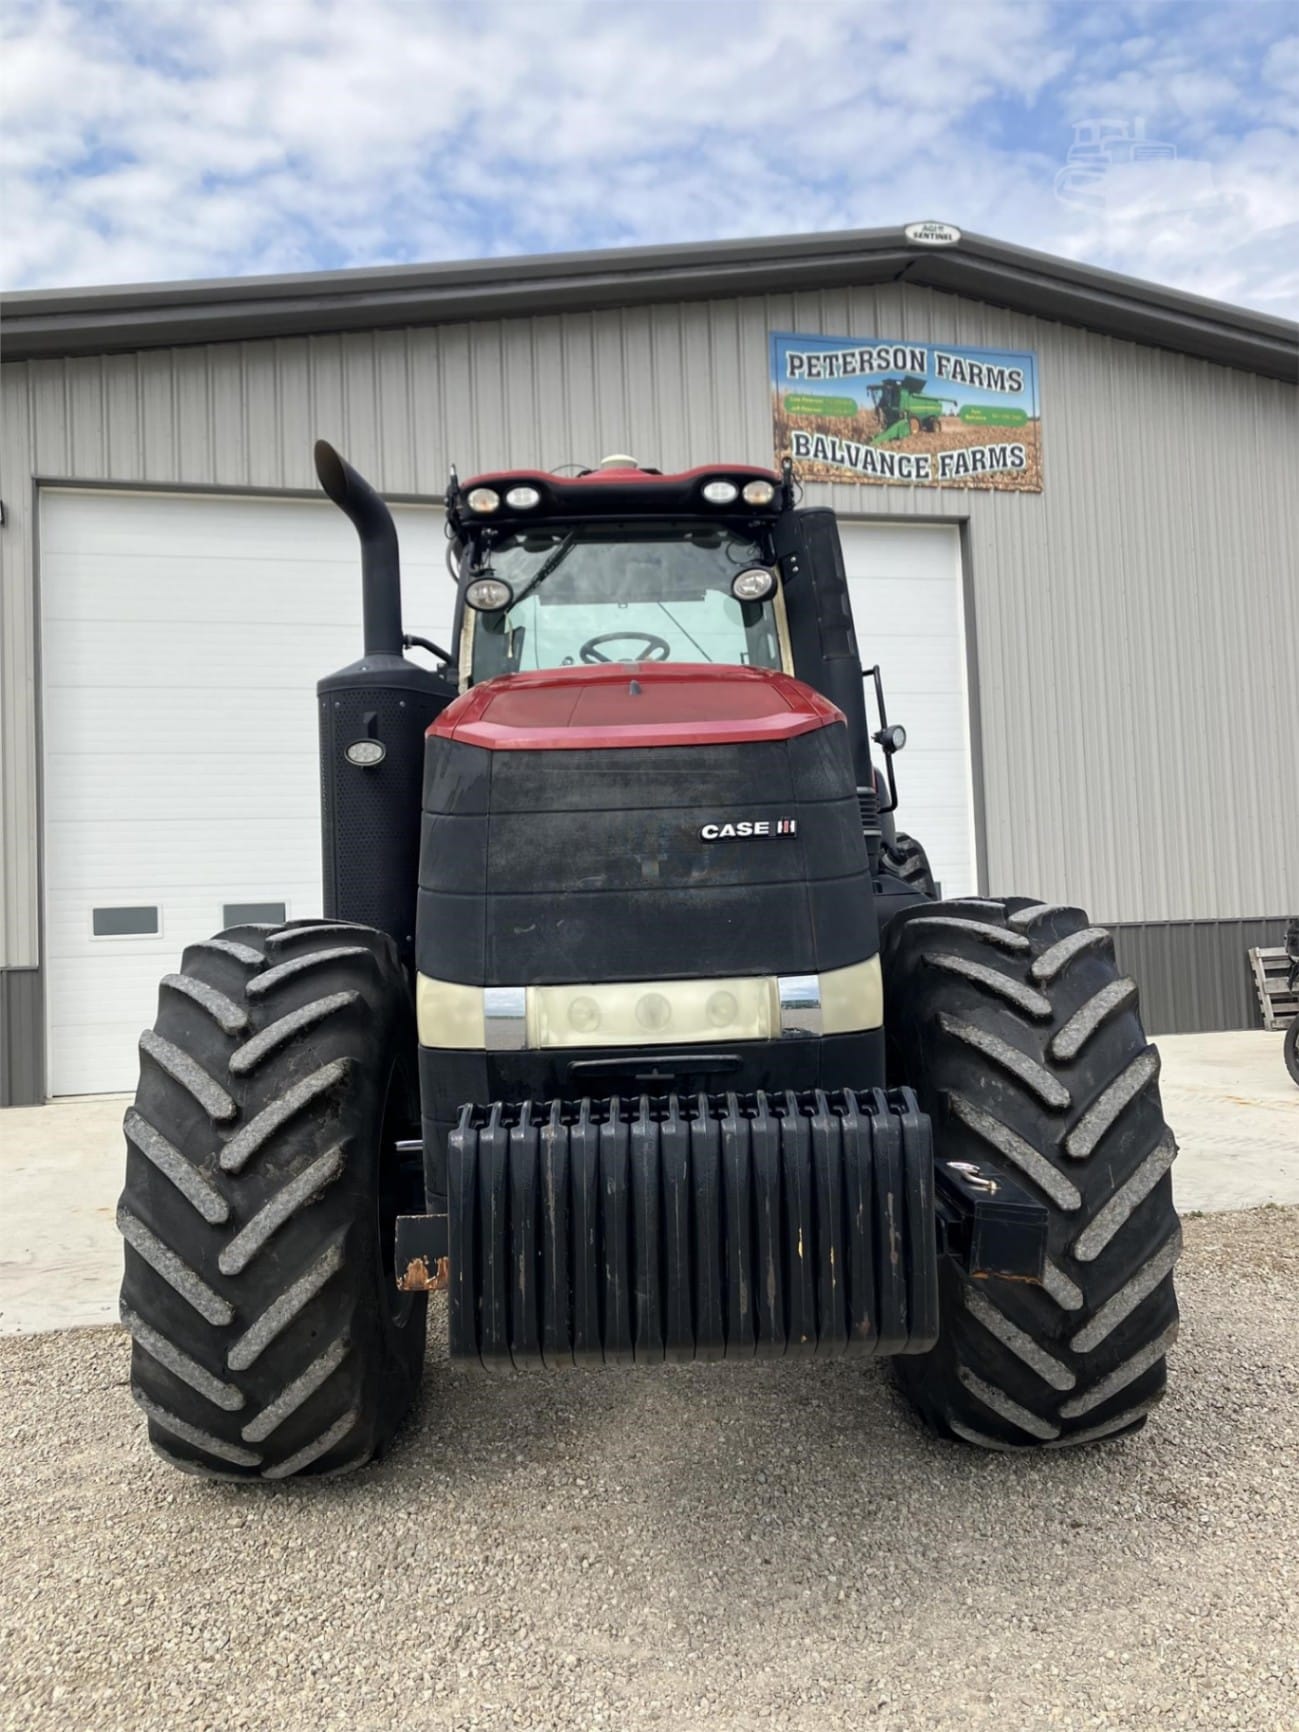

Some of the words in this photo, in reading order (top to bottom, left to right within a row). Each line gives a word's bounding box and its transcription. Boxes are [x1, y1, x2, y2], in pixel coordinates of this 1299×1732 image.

[787, 347, 927, 378] PETERSON
[935, 352, 1023, 392] FARMS
[792, 432, 931, 479] BALVANCE
[939, 444, 1024, 478] FARMS
[702, 822, 769, 839] CASE
